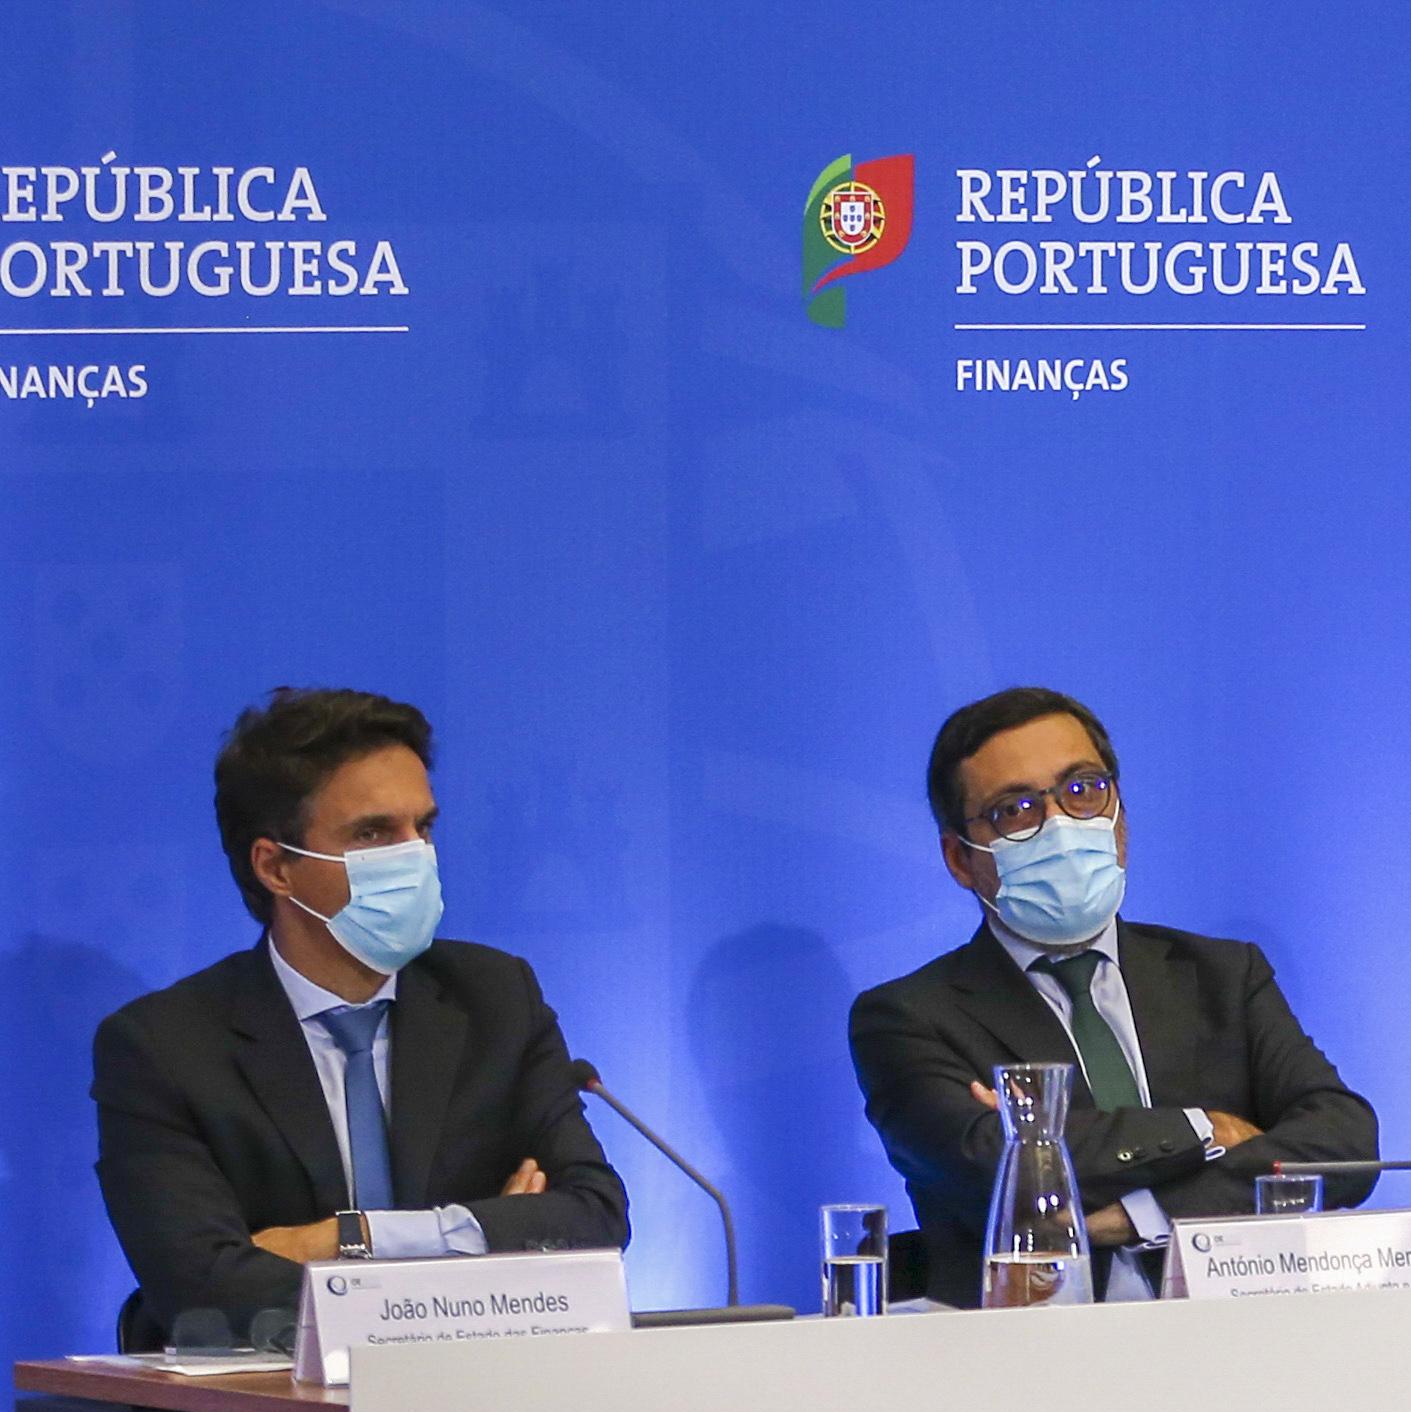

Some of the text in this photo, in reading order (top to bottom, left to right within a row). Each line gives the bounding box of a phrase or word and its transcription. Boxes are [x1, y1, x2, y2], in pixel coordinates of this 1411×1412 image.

[2, 151, 327, 222] EPÚBLICA
[956, 155, 1292, 223] REPÚBLICA
[0, 241, 410, 297] ORTUGUESA
[956, 241, 1366, 295] PORTUGUESA
[957, 359, 1129, 400] FINANÇAS
[1207, 1255, 1275, 1278] António
[1280, 1250, 1372, 1276] Mendonça
[380, 1291, 569, 1321] João Nuno Mendes
